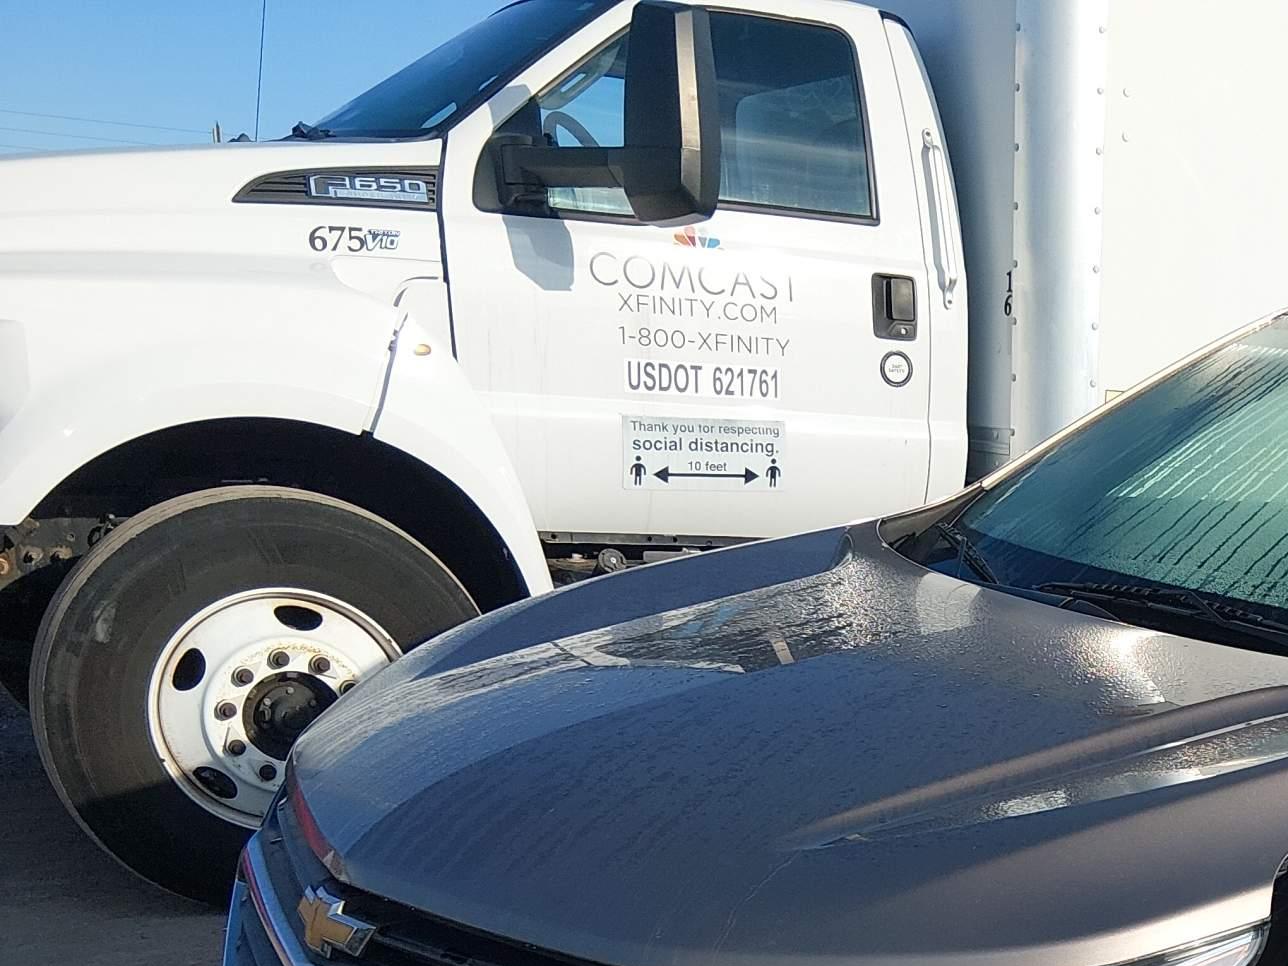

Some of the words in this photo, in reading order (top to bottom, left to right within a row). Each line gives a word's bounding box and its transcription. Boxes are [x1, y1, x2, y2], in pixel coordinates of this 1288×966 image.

[308, 225, 365, 252] 675
[364, 234, 400, 251] V10
[618, 292, 777, 325] XFINITY.COM
[617, 326, 791, 357] 1-800-XFINITY
[627, 360, 703, 394] USDOT
[712, 366, 778, 399] 621761
[630, 420, 669, 433] Thank
[671, 423, 695, 436] you
[698, 423, 715, 434] for
[718, 425, 780, 438] respecting
[632, 436, 683, 451] social
[688, 437, 780, 457] distancing.
[688, 461, 701, 471] 10
[705, 461, 728, 472] feet
